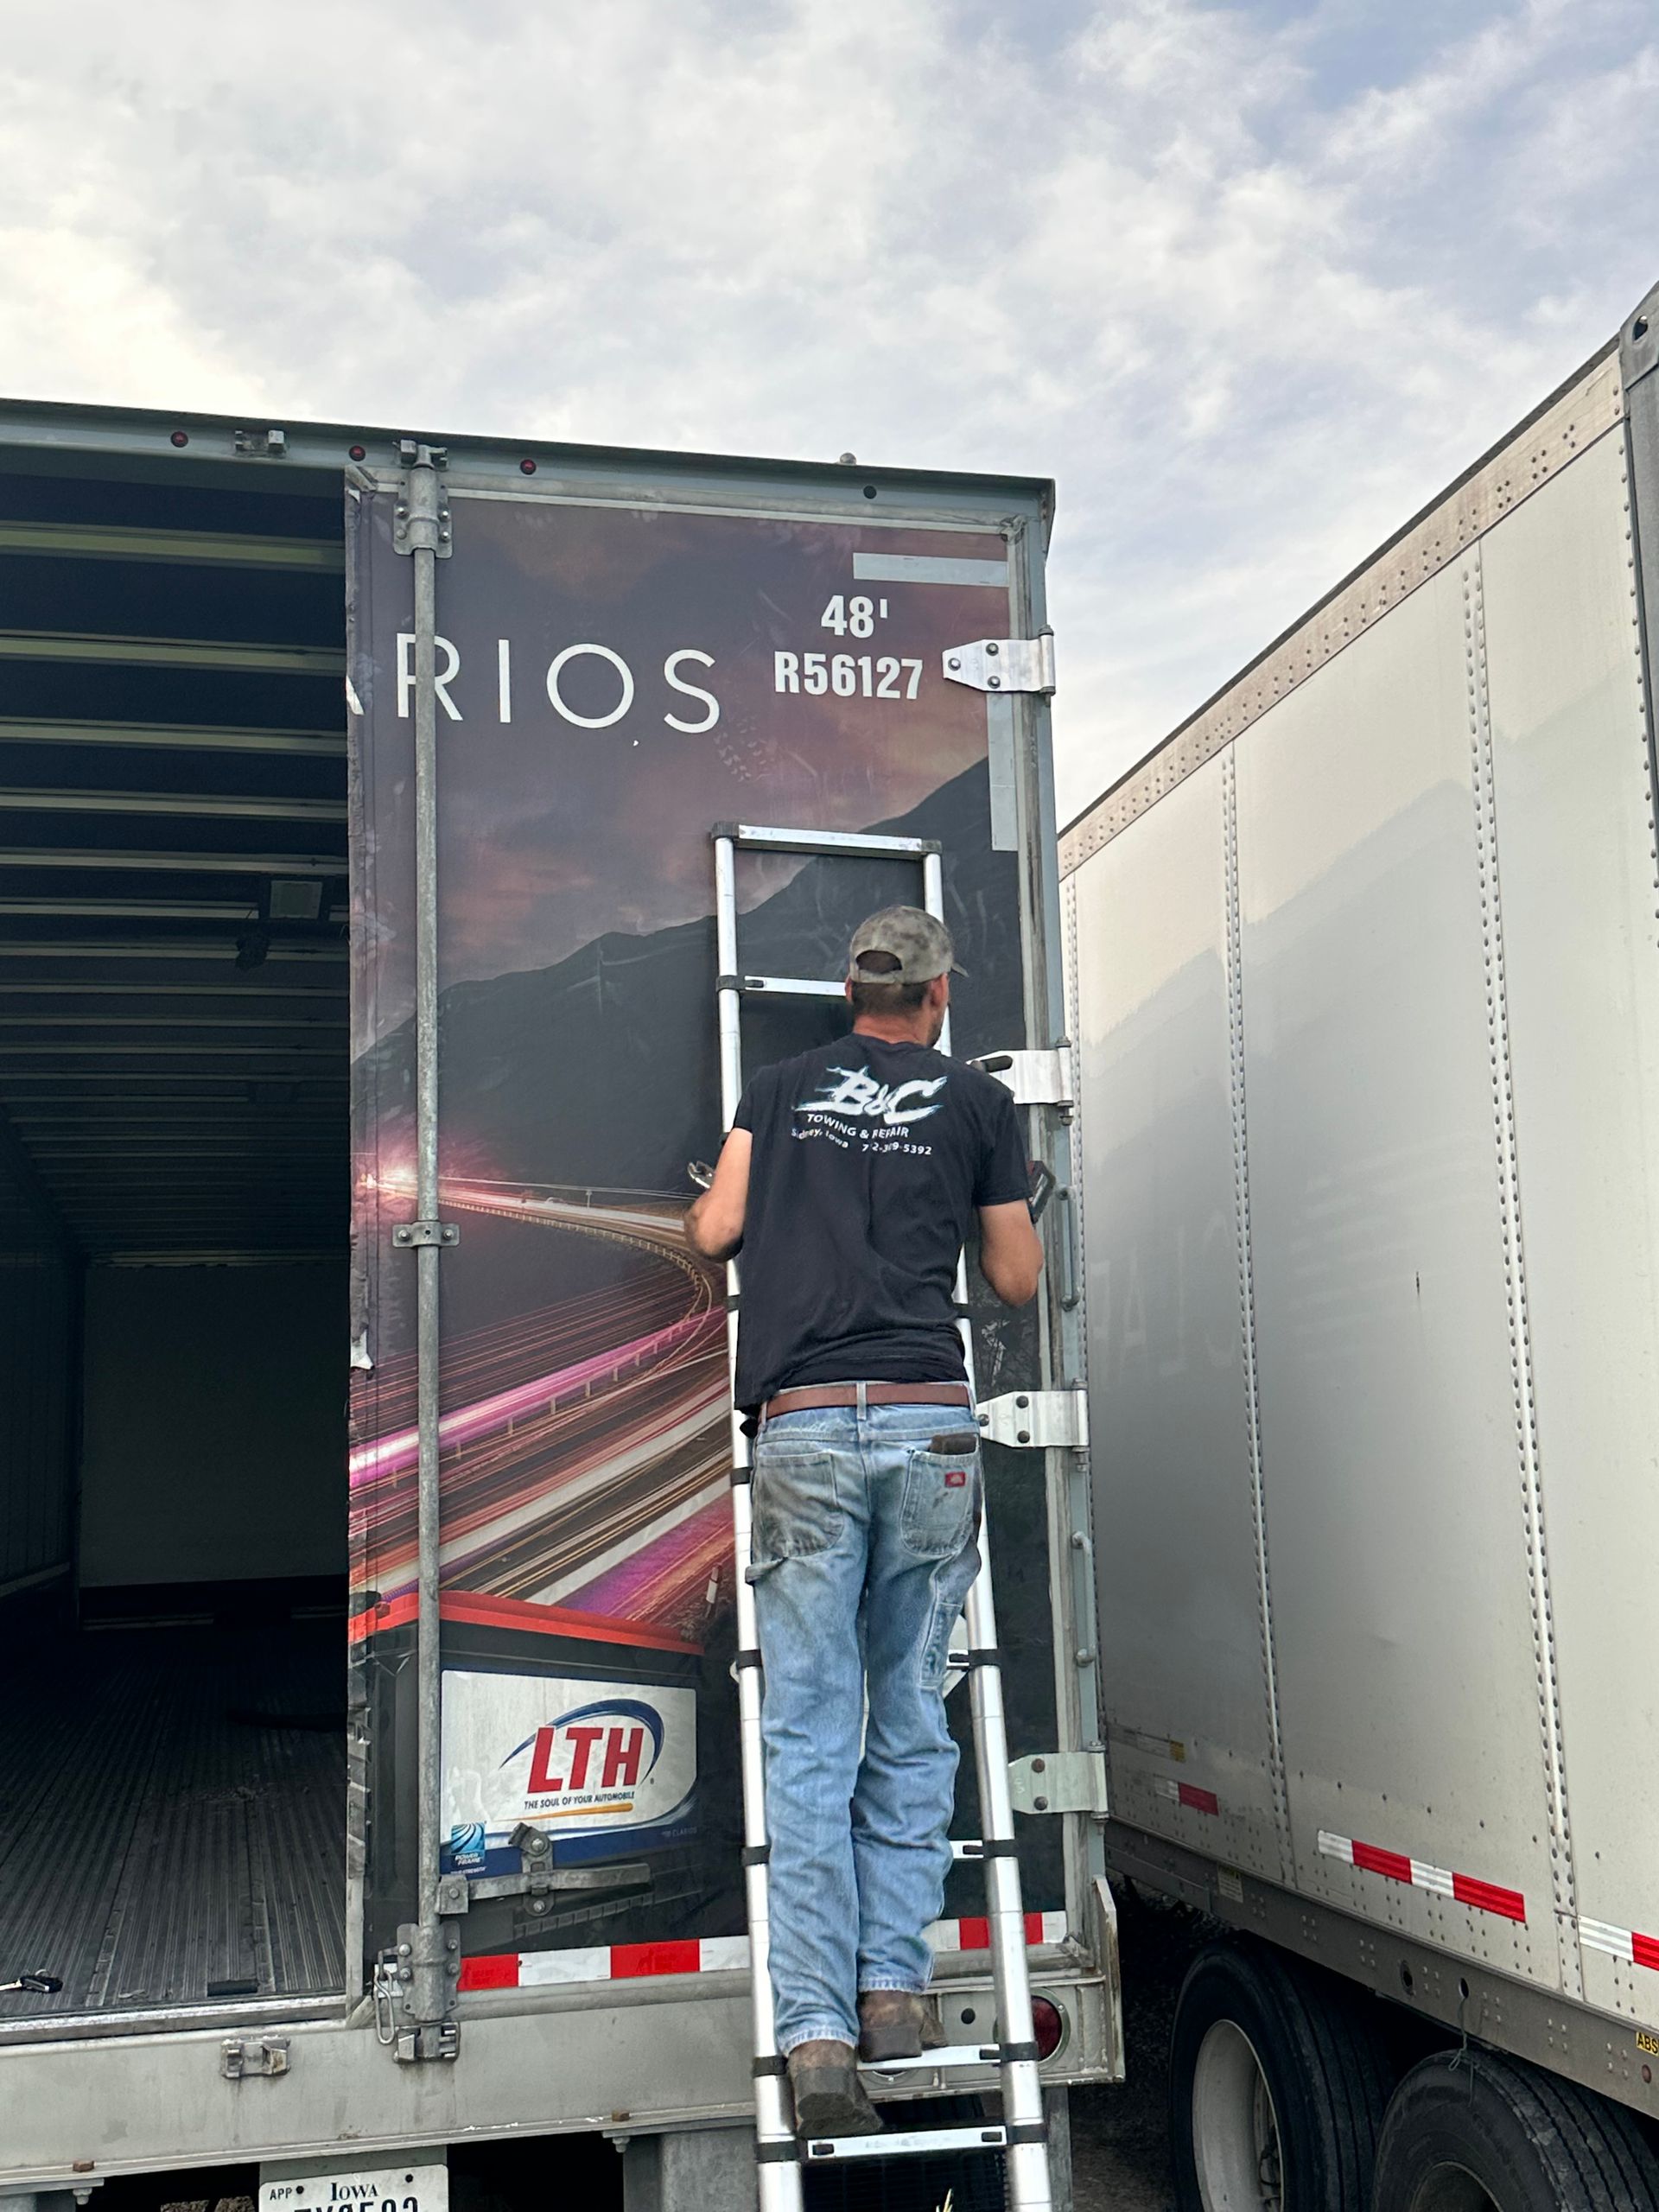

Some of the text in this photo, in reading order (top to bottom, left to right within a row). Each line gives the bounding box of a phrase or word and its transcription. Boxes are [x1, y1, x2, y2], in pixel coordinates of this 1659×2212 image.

[821, 594, 889, 638] 48'
[773, 651, 924, 700] R56127
[807, 1113, 910, 1140] TOWING & REPAIR
[825, 1129, 849, 1148] Iowa
[861, 1141, 932, 1156] 72-39-5392
[526, 1726, 645, 1795] LTH
[524, 1790, 636, 1810] THE SOUL OF YOUR AUTOMOBILE
[1637, 2032, 1658, 2055] ABS
[269, 2186, 293, 2201] APP
